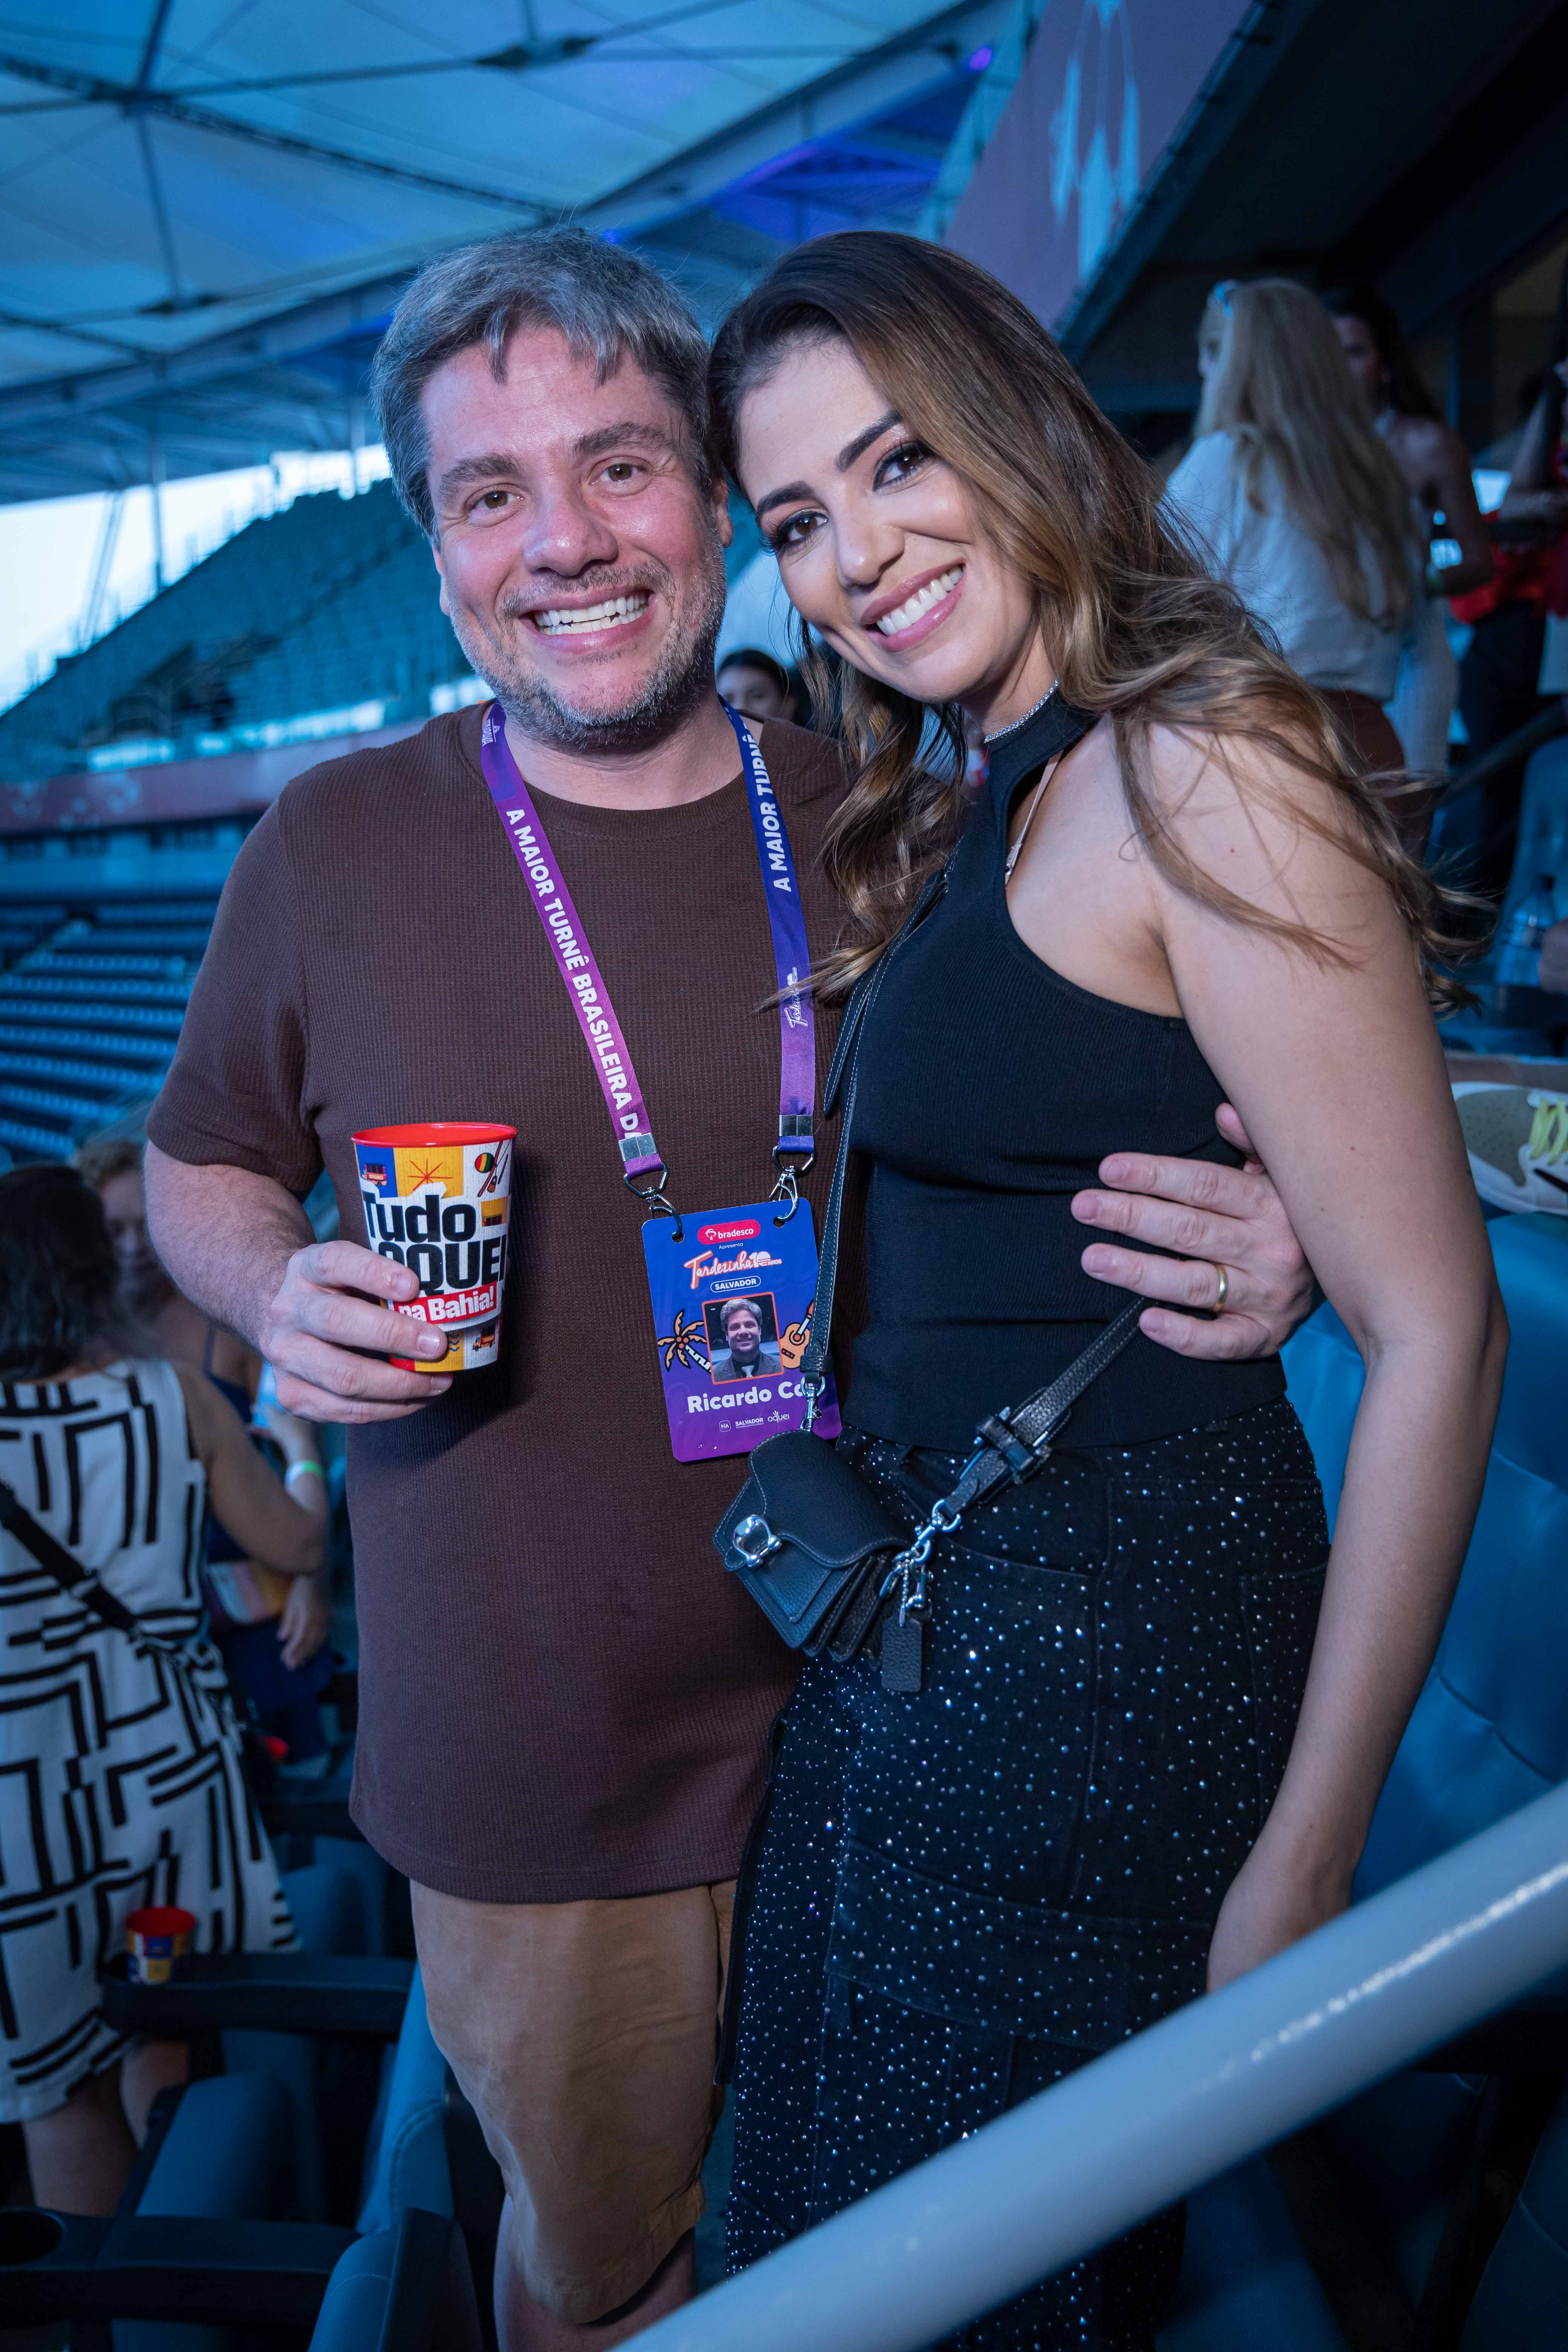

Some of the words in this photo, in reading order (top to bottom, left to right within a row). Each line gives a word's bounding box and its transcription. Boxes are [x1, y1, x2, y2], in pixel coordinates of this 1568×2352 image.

[506, 809, 525, 825] A
[760, 802, 787, 871] MAIOR
[514, 825, 555, 897] MAIOR
[773, 877, 792, 892] A
[544, 898, 590, 971] TURNÊ
[572, 973, 632, 1110] BRASILEIRA
[620, 1112, 642, 1138] D
[361, 1190, 476, 1243] Tudo
[718, 1228, 754, 1239] bradesco
[684, 1250, 753, 1289] Tardezinha
[715, 1278, 756, 1290] SALVADOR
[427, 1285, 495, 1321] Bahia!
[687, 1386, 772, 1413] Ricardo
[735, 1418, 763, 1426] SALVADOR
